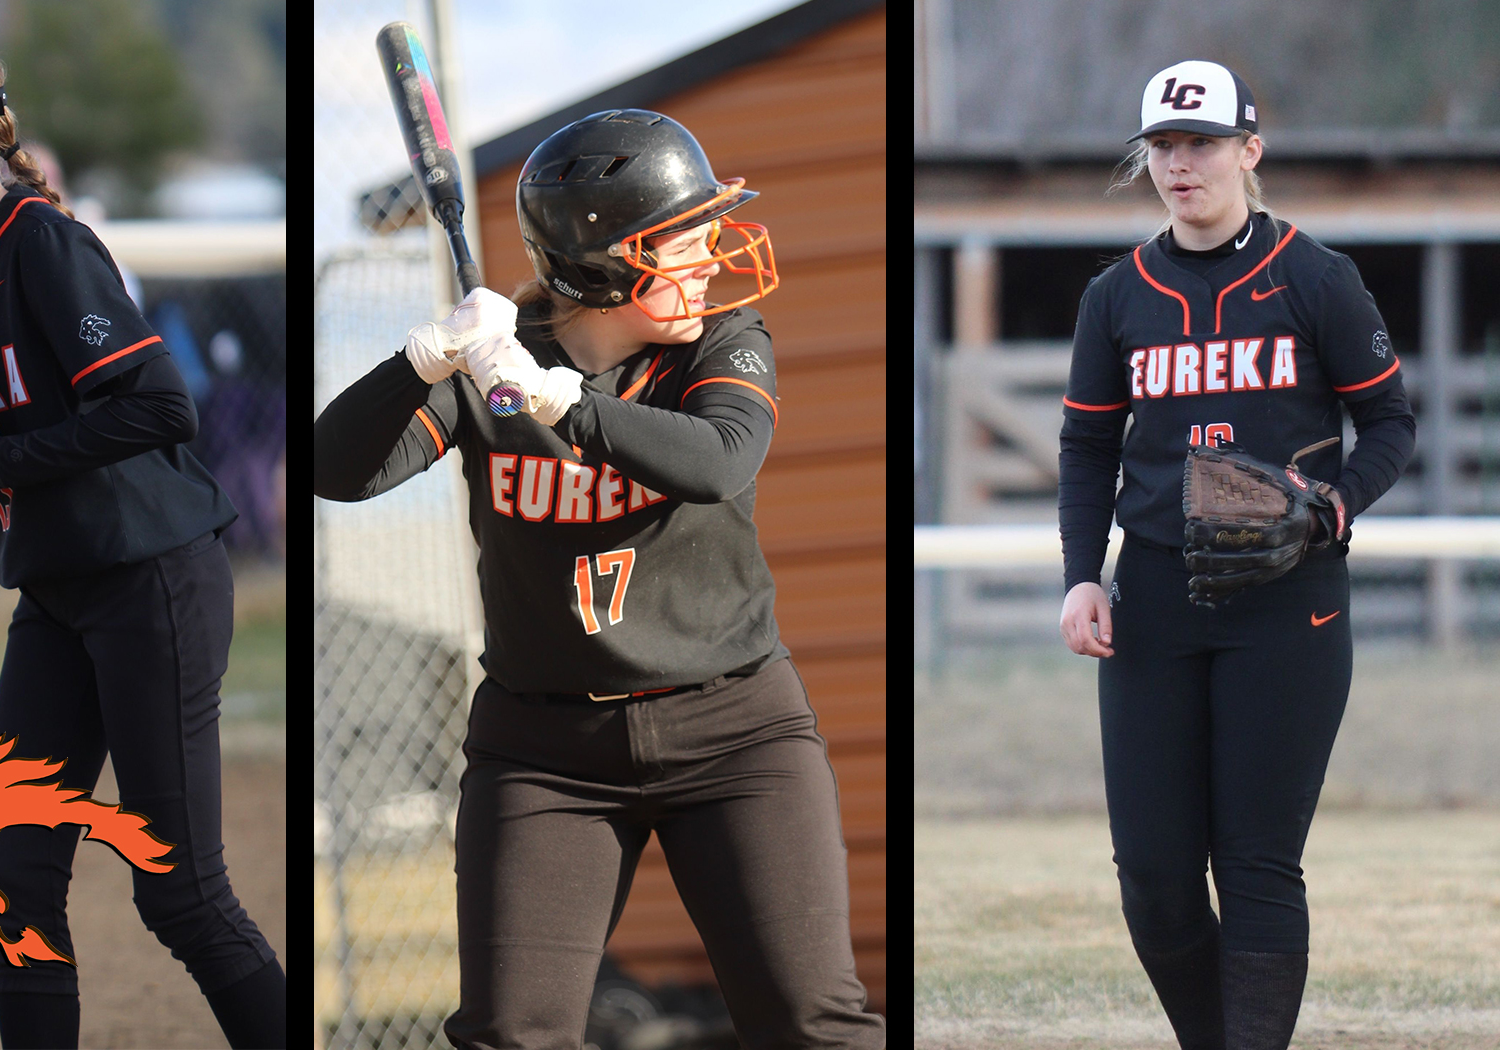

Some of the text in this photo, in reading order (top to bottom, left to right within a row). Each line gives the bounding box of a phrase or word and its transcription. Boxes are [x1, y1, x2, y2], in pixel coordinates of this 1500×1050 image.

[1160, 77, 1206, 110] LC
[553, 277, 584, 300] schutt
[1129, 336, 1298, 399] EUREKA
[573, 547, 636, 635] 17
